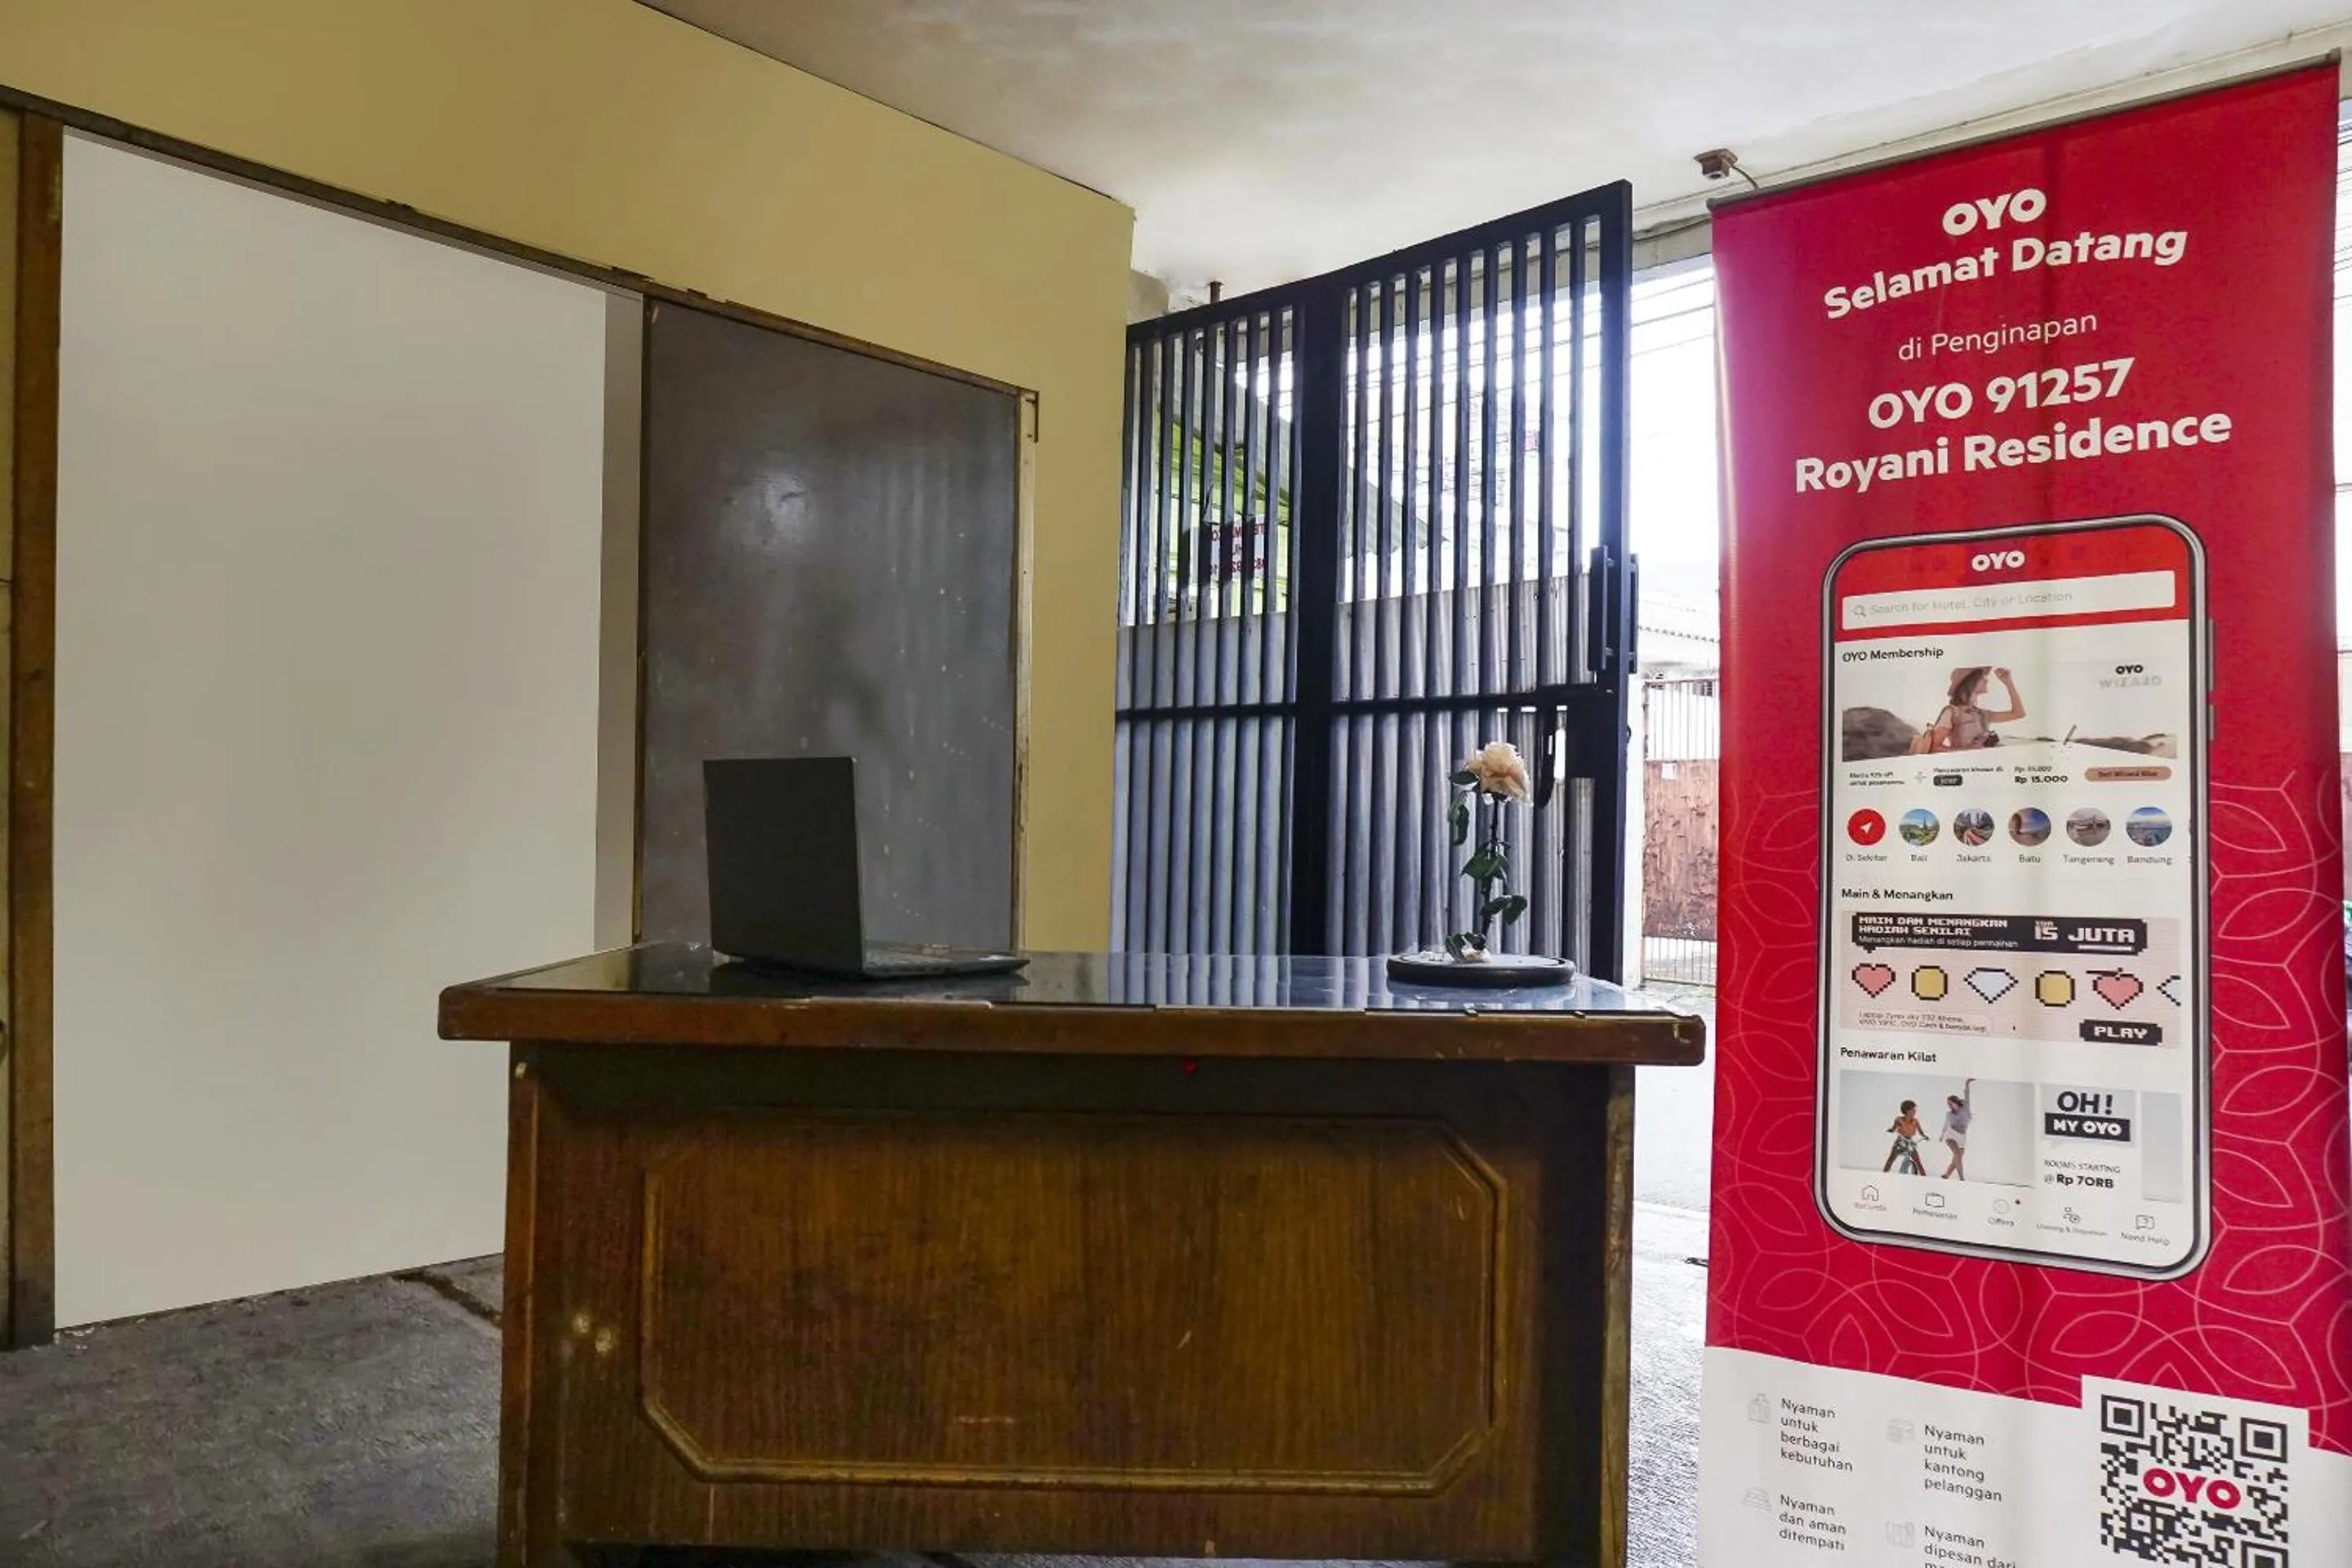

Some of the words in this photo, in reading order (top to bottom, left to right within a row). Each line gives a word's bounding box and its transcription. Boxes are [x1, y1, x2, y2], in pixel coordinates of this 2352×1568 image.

[1942, 188, 2047, 236] OYO
[1824, 247, 1999, 319] Selamat
[2011, 231, 2189, 272] Datang
[1898, 336, 1922, 360] di
[1931, 314, 2097, 355] Penginapan
[1868, 382, 1973, 429] OYO
[1985, 357, 2136, 413] 91257
[1796, 436, 1949, 493] Royani
[1963, 412, 2232, 471] Residence
[1971, 550, 2025, 572] OYO
[1870, 603, 1909, 614] Search
[1912, 601, 1929, 612] for
[1973, 595, 1998, 610] City
[2000, 597, 2014, 607] or
[2017, 592, 2074, 604] Location
[1842, 650, 1868, 662] OYO
[1870, 647, 1944, 661] Membership
[2115, 664, 2144, 675] OYO
[2014, 776, 2027, 785] Rp
[2031, 775, 2069, 784] 15.000
[2018, 853, 2042, 863] Batu
[2062, 853, 2115, 866] Tangerang
[2127, 855, 2172, 866] Bandung
[1842, 888, 1869, 899] Main
[1872, 889, 1882, 900] &
[1883, 889, 1954, 902] Menangkan
[1859, 916, 1894, 925] MAIN
[1897, 917, 1924, 927] DAN
[1927, 918, 2008, 929] MENANGKAN
[1859, 924, 1909, 935] HADIAH
[1913, 926, 1972, 936] SENILAI
[2067, 927, 2136, 943] JUTA
[2094, 1026, 2148, 1039] PLAY
[1840, 1046, 1904, 1061] Penawaran
[1907, 1051, 1938, 1062] Kilat
[2053, 1118, 2079, 1133] MY
[2082, 1120, 2123, 1136] OYO
[2044, 1159, 2076, 1170] ROOMS
[2077, 1162, 2121, 1174] STARTING
[2056, 1174, 2074, 1187] Rp
[1781, 1397, 1836, 1419] Nyaman
[1780, 1416, 1820, 1434] untuk
[1924, 1423, 1985, 1446] Nyaman
[1780, 1429, 1840, 1454] berbagai
[1924, 1443, 1967, 1461] untuk
[1780, 1446, 1853, 1472] kebutuhan
[1924, 1458, 1985, 1484] kantong
[1924, 1477, 2002, 1502] pelanggan
[2142, 1467, 2242, 1510] OYO
[1780, 1494, 1836, 1516] Nyaman
[1779, 1511, 1805, 1526] dan
[1808, 1519, 1847, 1535] aman
[1779, 1527, 1846, 1552] ditempati
[1924, 1525, 1985, 1549] Nyaman
[1923, 1543, 1983, 1566] dipesan
